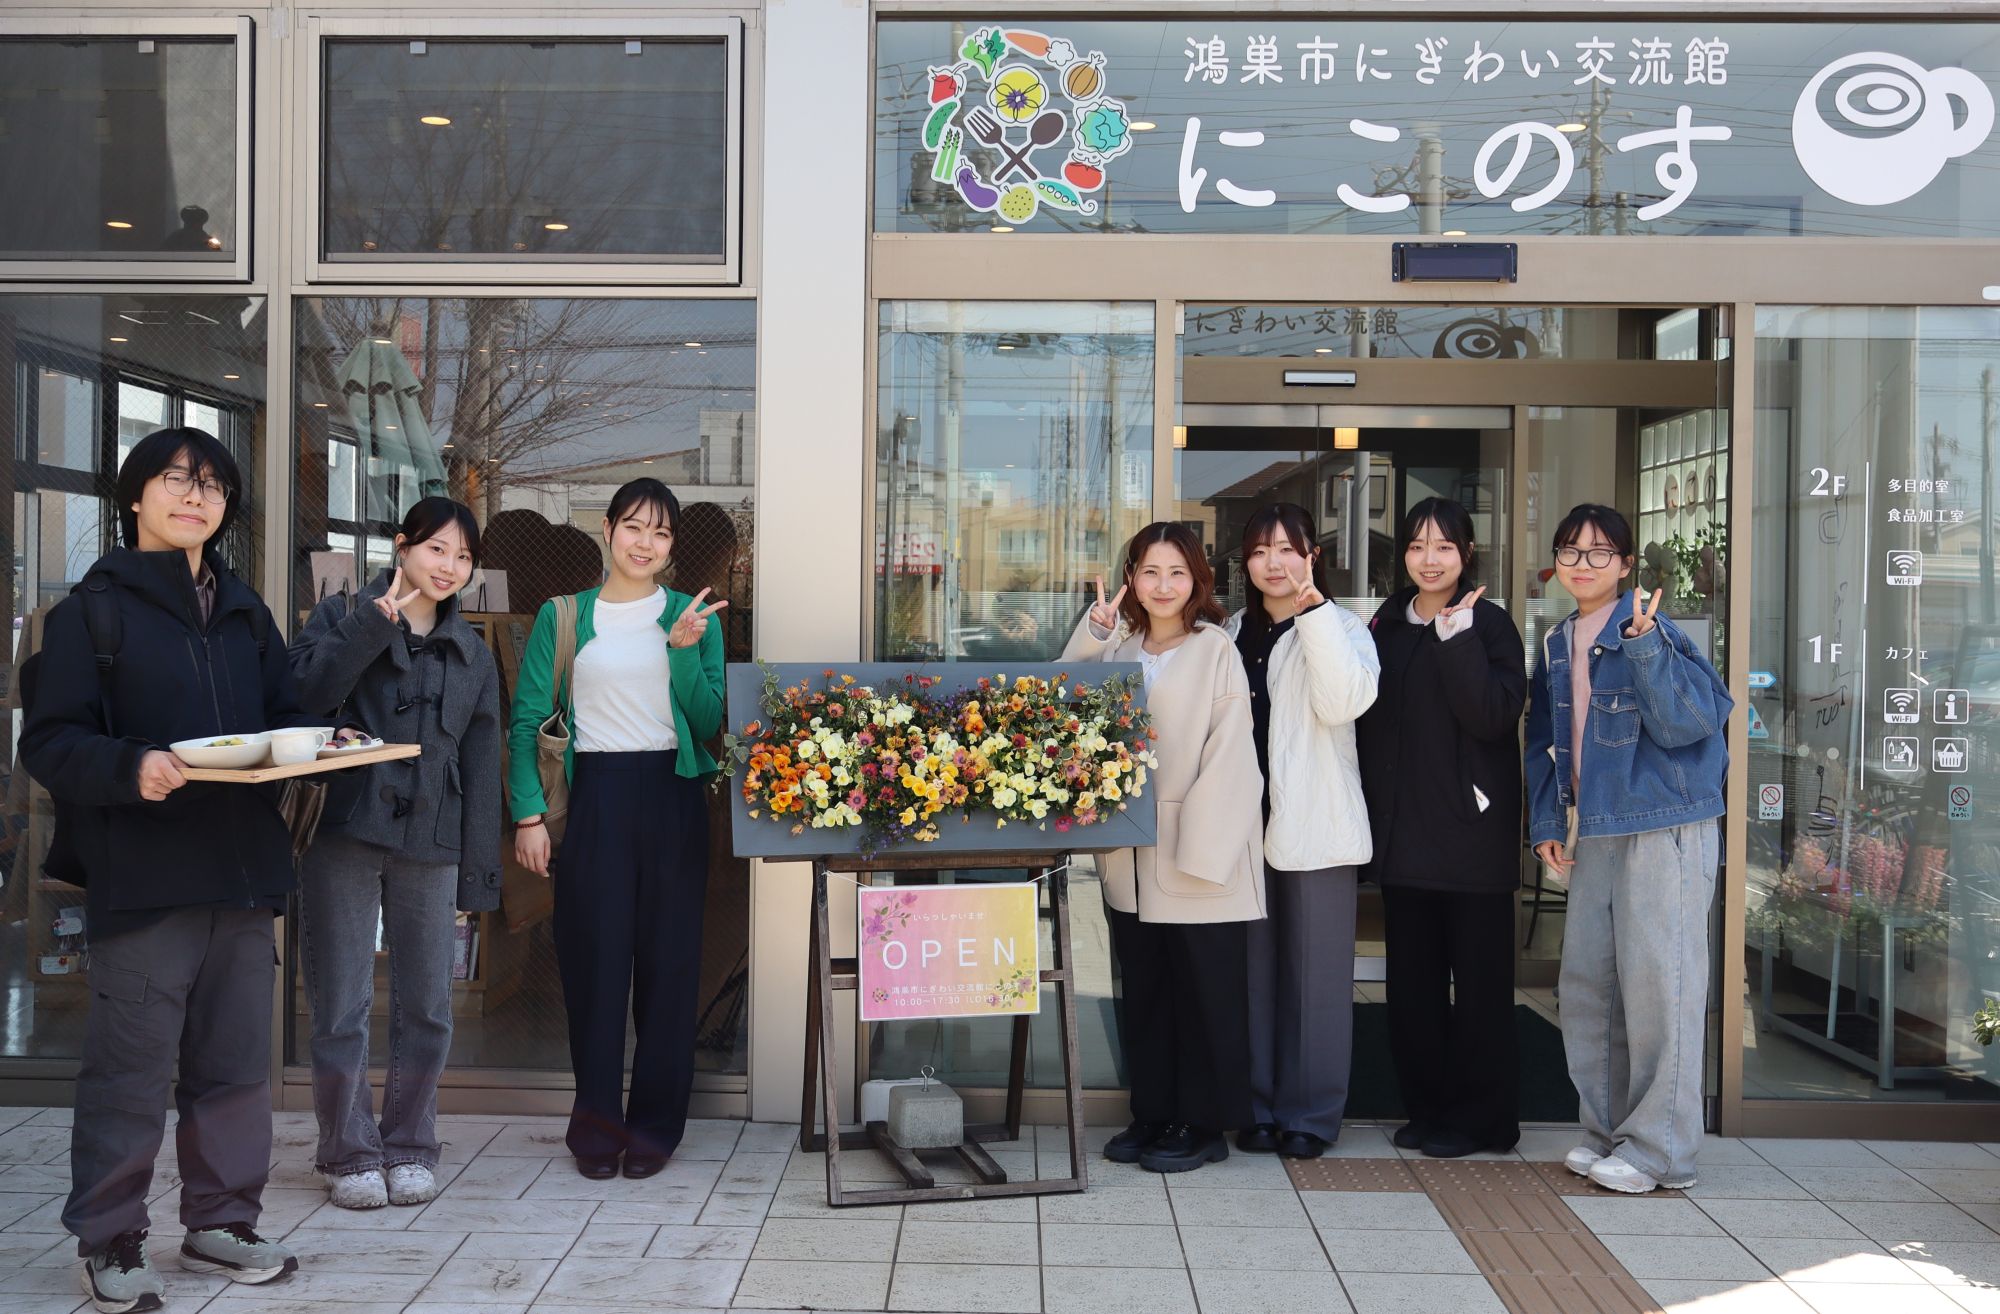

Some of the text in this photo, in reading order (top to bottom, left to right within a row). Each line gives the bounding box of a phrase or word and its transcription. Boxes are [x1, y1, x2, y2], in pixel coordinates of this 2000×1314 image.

[1184, 35, 1729, 86] 鴻巣市にぎわい交流館
[1178, 105, 1732, 221] にこのす
[1809, 467, 1846, 496] 2F
[1887, 478, 1949, 493] 多目的室
[1887, 508, 1964, 523] 食品加工室
[1894, 577, 1915, 585] Wi-Fi
[1807, 634, 1843, 663] 1F
[1885, 646, 1929, 660] カフェ
[1891, 715, 1913, 723] Wi-Fi
[882, 937, 1015, 970] OPEN
